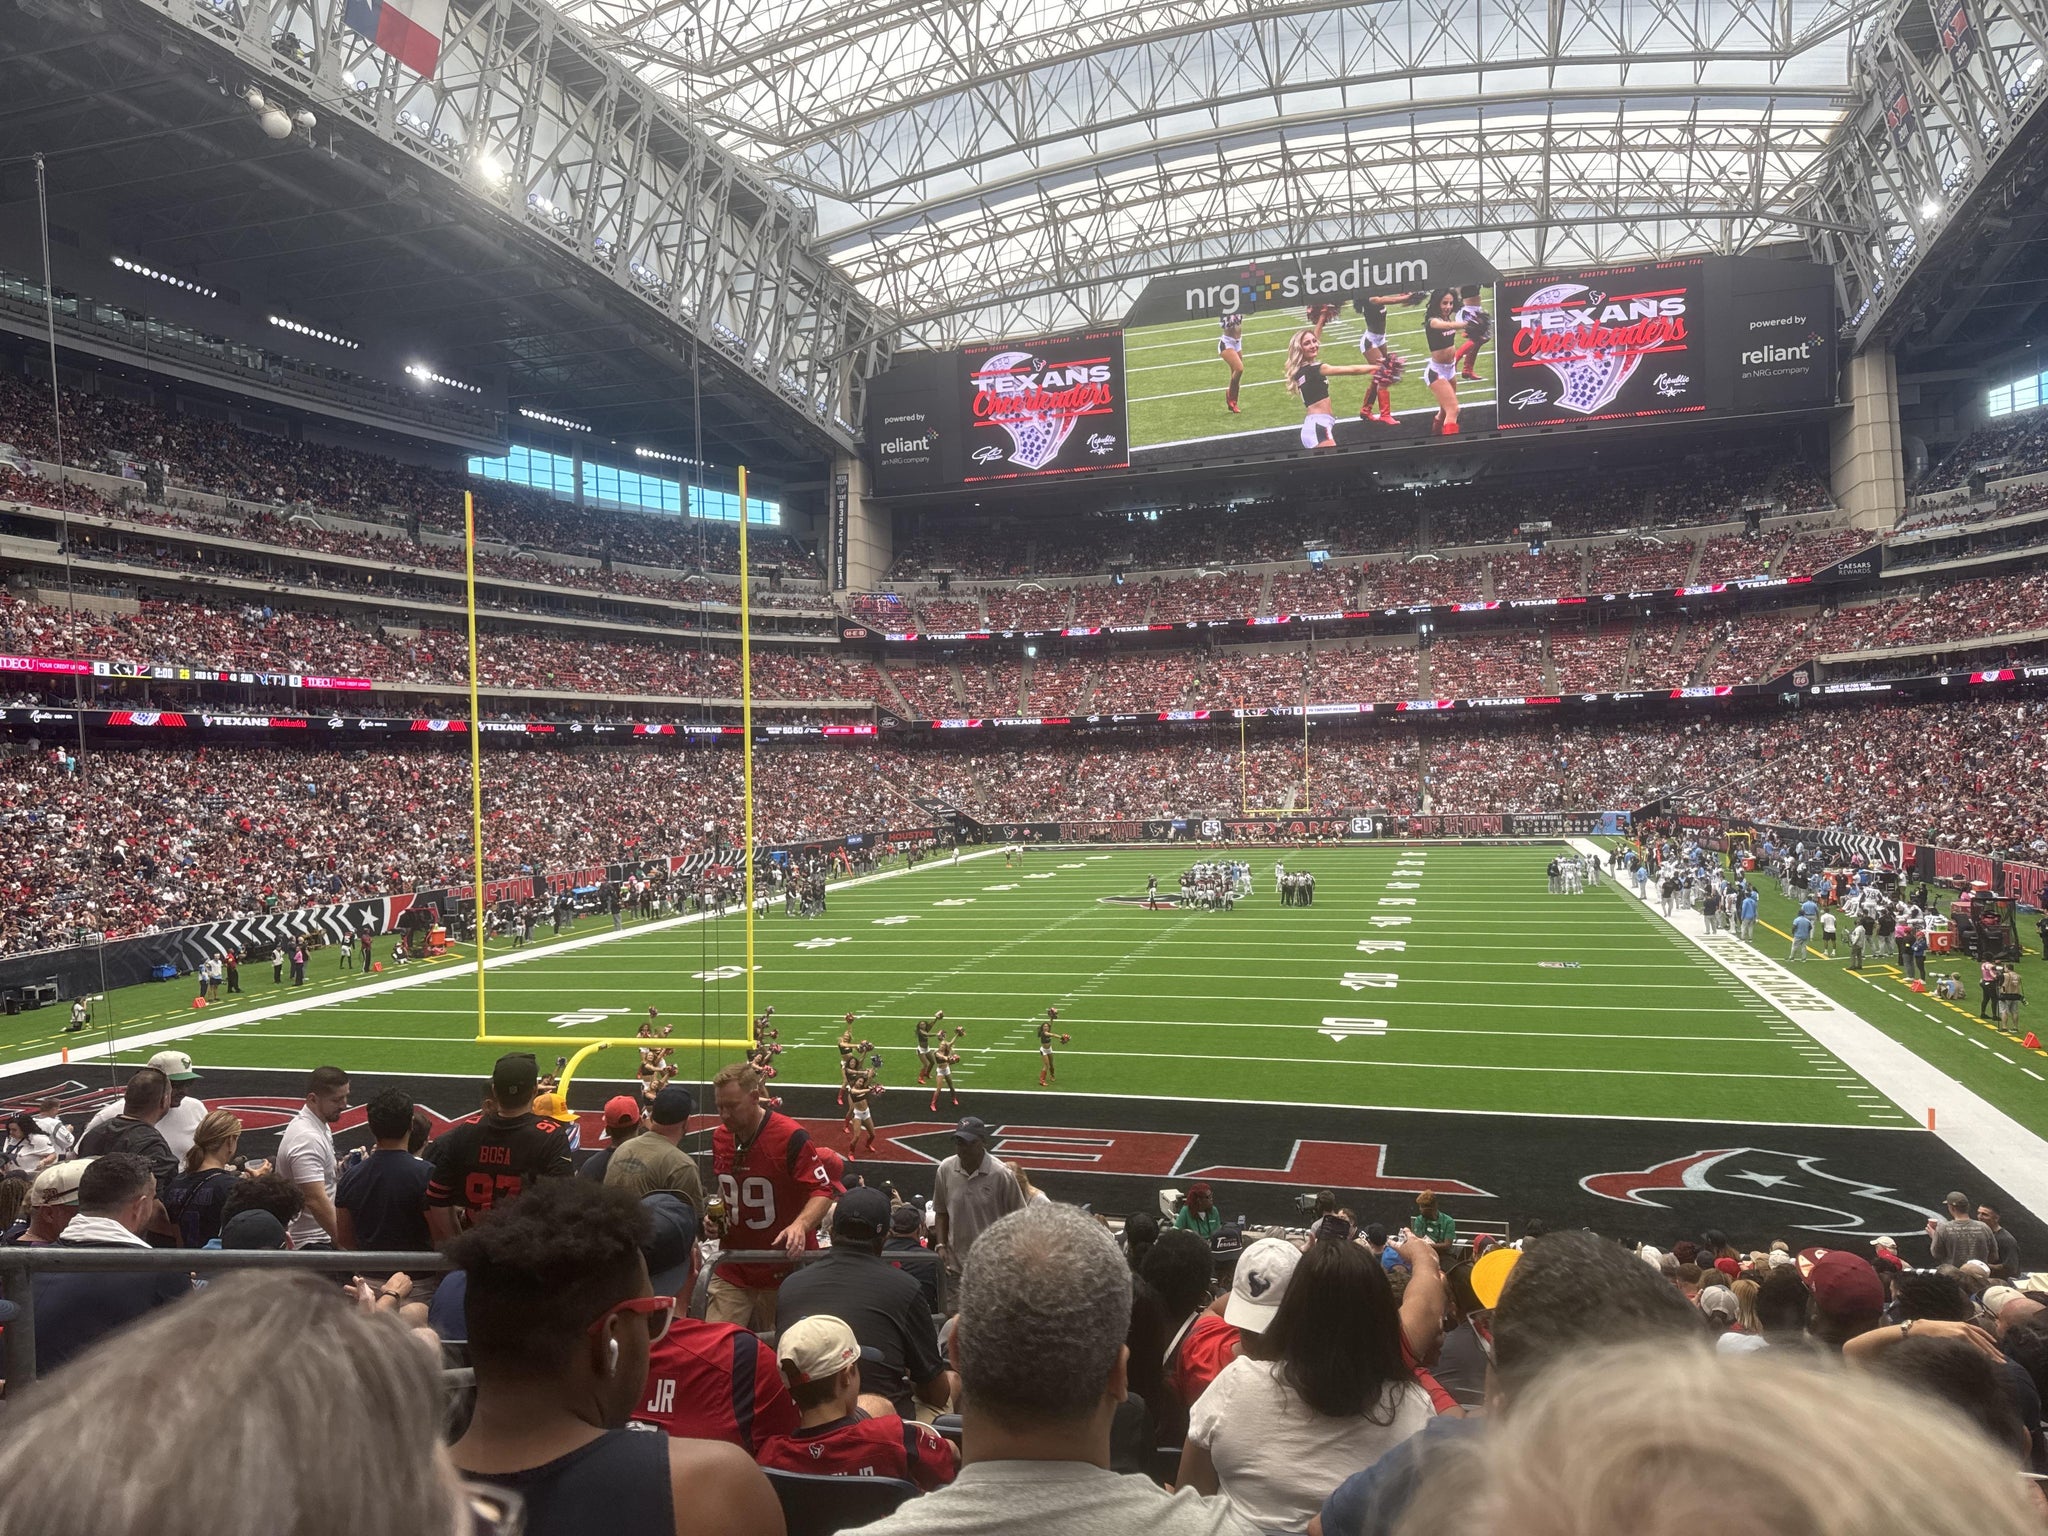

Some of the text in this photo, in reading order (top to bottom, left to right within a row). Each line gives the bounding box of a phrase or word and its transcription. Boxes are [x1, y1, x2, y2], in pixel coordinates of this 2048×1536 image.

[1186, 256, 1428, 315] nrg stadium
[1511, 298, 1686, 329] TEXANS
[1750, 316, 1807, 330] powered by
[1512, 317, 1687, 356] Cheerleaders
[1742, 343, 1811, 365] reliant
[1753, 369, 1772, 378] NRG
[1773, 366, 1810, 377] company
[971, 366, 1111, 392] TEXANS
[973, 384, 1113, 416] Cheerleaders
[885, 413, 925, 424] powered by
[881, 437, 930, 454] reliant
[904, 456, 930, 465] company
[1838, 562, 1871, 570] CAESARS
[1838, 568, 1871, 576] REWARDS
[1747, 579, 1787, 588] TEXANS
[1519, 598, 1557, 606] TEXANS
[1308, 613, 1343, 621] TEXANS
[307, 678, 334, 688] TDECU
[1477, 698, 1525, 706] TEXANS
[214, 717, 269, 727] TEXANS
[486, 723, 526, 731] TEXANS
[1000, 718, 1041, 726] TEXANS
[690, 726, 722, 734] TEXANS
[1204, 822, 1219, 833] 25
[1224, 821, 1351, 834] TEXANS
[1354, 820, 1370, 831] 25
[889, 830, 934, 840] HOUSTON
[1935, 848, 1993, 891] HOUSTON
[1937, 936, 1948, 947] G
[1747, 974, 1835, 1012] CANCER
[1317, 1017, 1388, 1036] 10
[479, 1146, 511, 1166] BOSA
[813, 1165, 830, 1187] 9
[466, 1172, 522, 1212] 97
[718, 1173, 776, 1230] 99
[647, 1379, 676, 1413] JR
